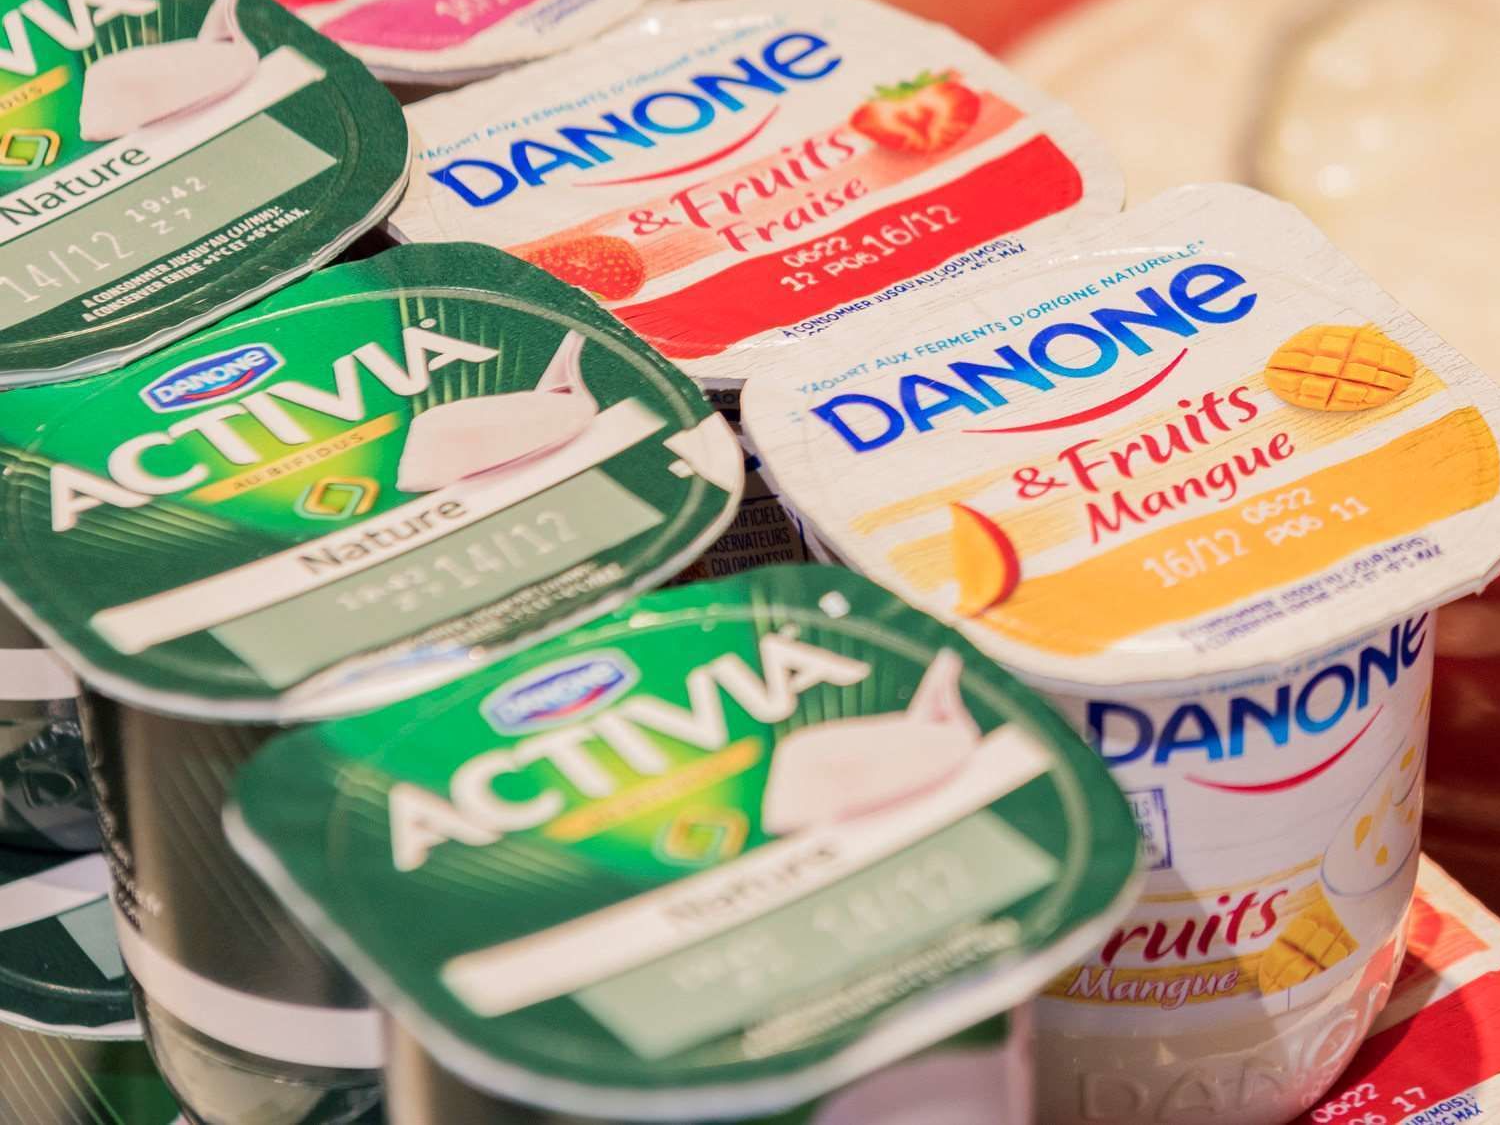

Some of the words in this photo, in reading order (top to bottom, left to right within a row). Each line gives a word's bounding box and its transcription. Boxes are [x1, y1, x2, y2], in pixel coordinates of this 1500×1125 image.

[427, 31, 842, 208] DANONE
[0, 147, 151, 226] Nature
[628, 210, 681, 236] &
[670, 131, 857, 228] Fruits
[716, 178, 869, 252] Fraise
[0, 231, 134, 303] 14/12
[862, 205, 960, 256] 16/12
[92, 263, 170, 303] CONSOMMER
[92, 281, 163, 317] CONSERVER
[164, 261, 206, 286] ENTRE
[792, 301, 872, 334] CONSOMMER
[152, 349, 270, 403] DANONE
[800, 362, 870, 395] YAOURT
[875, 350, 913, 371] AUX
[914, 322, 1007, 359] FERMENTS
[1008, 283, 1099, 328] D'ORIGINE
[809, 262, 1259, 454] DANONE
[49, 326, 499, 532] ACTIVIA
[1012, 466, 1068, 499] &
[1057, 383, 1261, 492] Fruits
[1085, 432, 1295, 545] Mangue
[299, 497, 467, 574] Nature
[1143, 528, 1248, 587] 16/12
[1087, 611, 1430, 769] DANONE
[388, 633, 870, 871] ACTIVIA
[1101, 889, 1290, 966] ruits
[1067, 965, 1240, 1011] Mangue
[1392, 1086, 1427, 1113] 17
